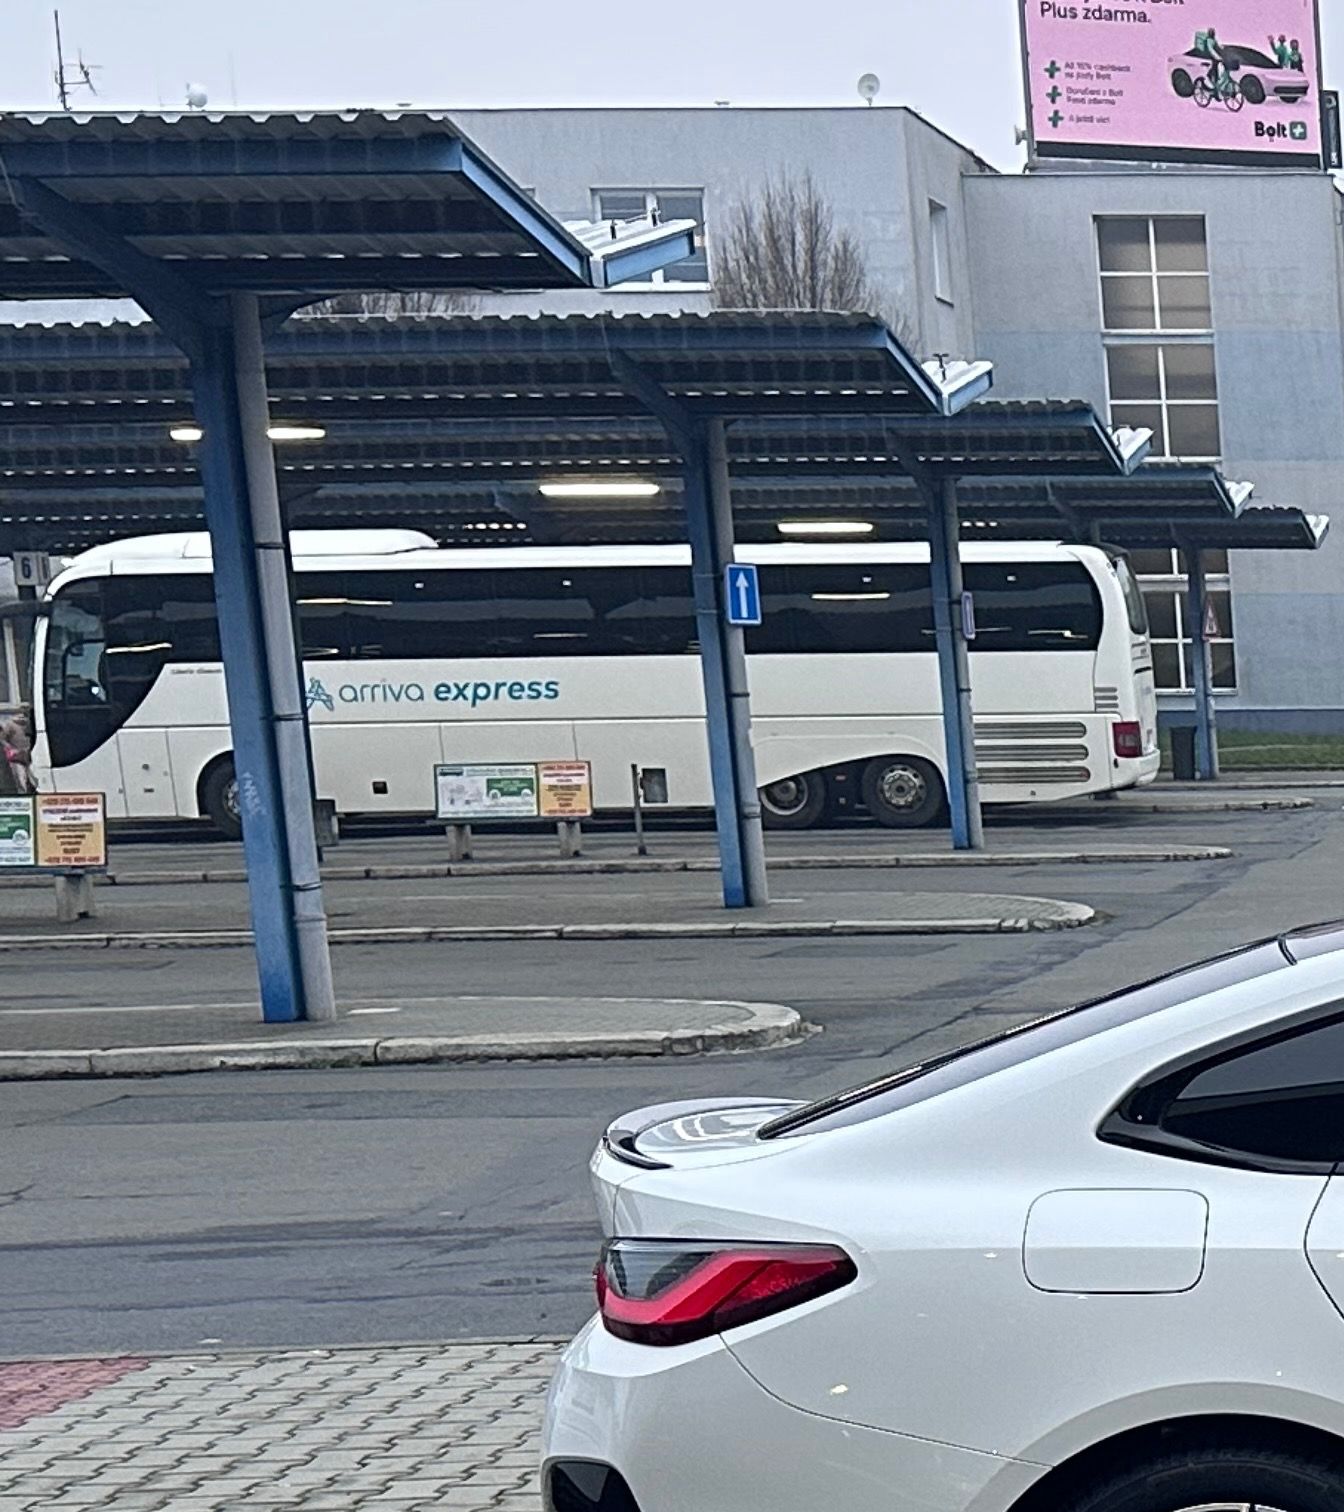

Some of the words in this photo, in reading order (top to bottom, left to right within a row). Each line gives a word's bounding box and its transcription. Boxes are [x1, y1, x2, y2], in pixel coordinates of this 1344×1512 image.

[1040, 1, 1078, 19] Plus
[1082, 5, 1152, 23] zdarma.
[1254, 121, 1288, 138] Bolt
[339, 678, 425, 703] arriva
[434, 679, 560, 708] express
